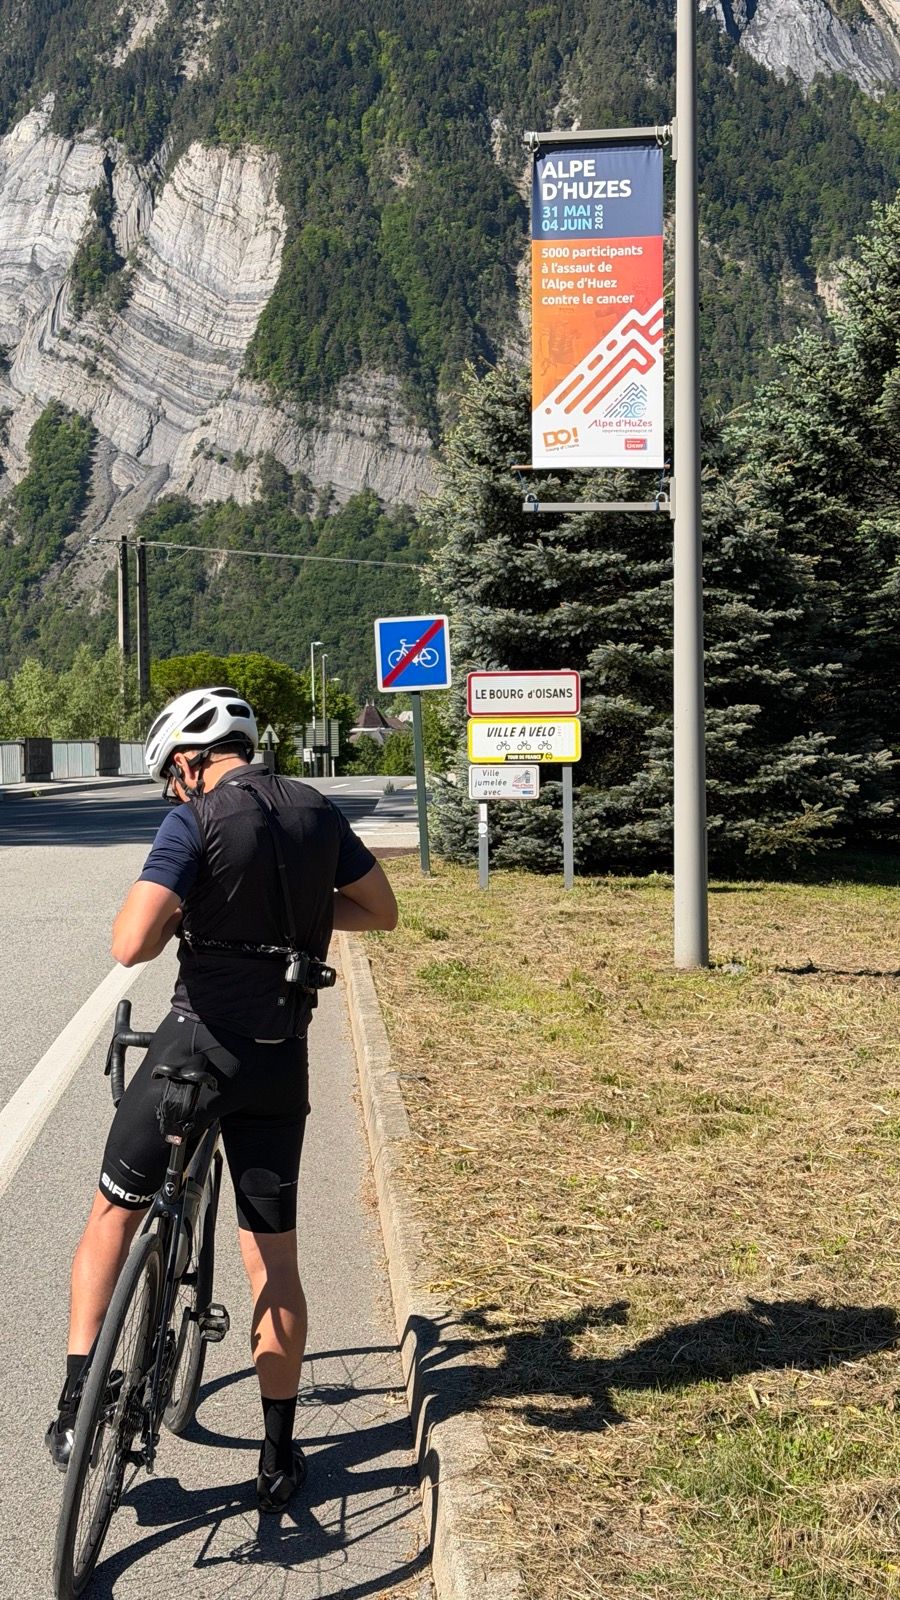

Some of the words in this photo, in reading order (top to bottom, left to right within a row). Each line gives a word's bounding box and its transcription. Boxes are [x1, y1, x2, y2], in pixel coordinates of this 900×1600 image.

[541, 159, 596, 179] ALPE
[542, 179, 632, 200] D'HUZES
[543, 206, 558, 218] 31
[563, 204, 591, 217] MAI
[594, 204, 604, 230] 2026
[541, 219, 558, 231] 04
[560, 218, 592, 231] JUIN
[541, 247, 570, 258] 5000
[572, 245, 643, 259] participants
[541, 262, 549, 274] à
[551, 262, 595, 273] l'assaut
[597, 261, 613, 272] de
[541, 278, 574, 291] l'Alpe
[577, 277, 618, 289] d'Huez
[541, 294, 580, 305] contre
[582, 293, 594, 304] le
[596, 294, 635, 304] cancer
[588, 419, 614, 428] Alpe
[615, 419, 653, 427] d'HuZes
[475, 689, 487, 699] LE
[489, 688, 524, 699] BOURG
[527, 688, 573, 699] d'OISANS
[487, 726, 517, 737] VILLE
[528, 724, 556, 737] VÉLO
[482, 769, 500, 777] Ville
[474, 778, 507, 788] jumelée
[101, 1172, 155, 1203] SIROK
